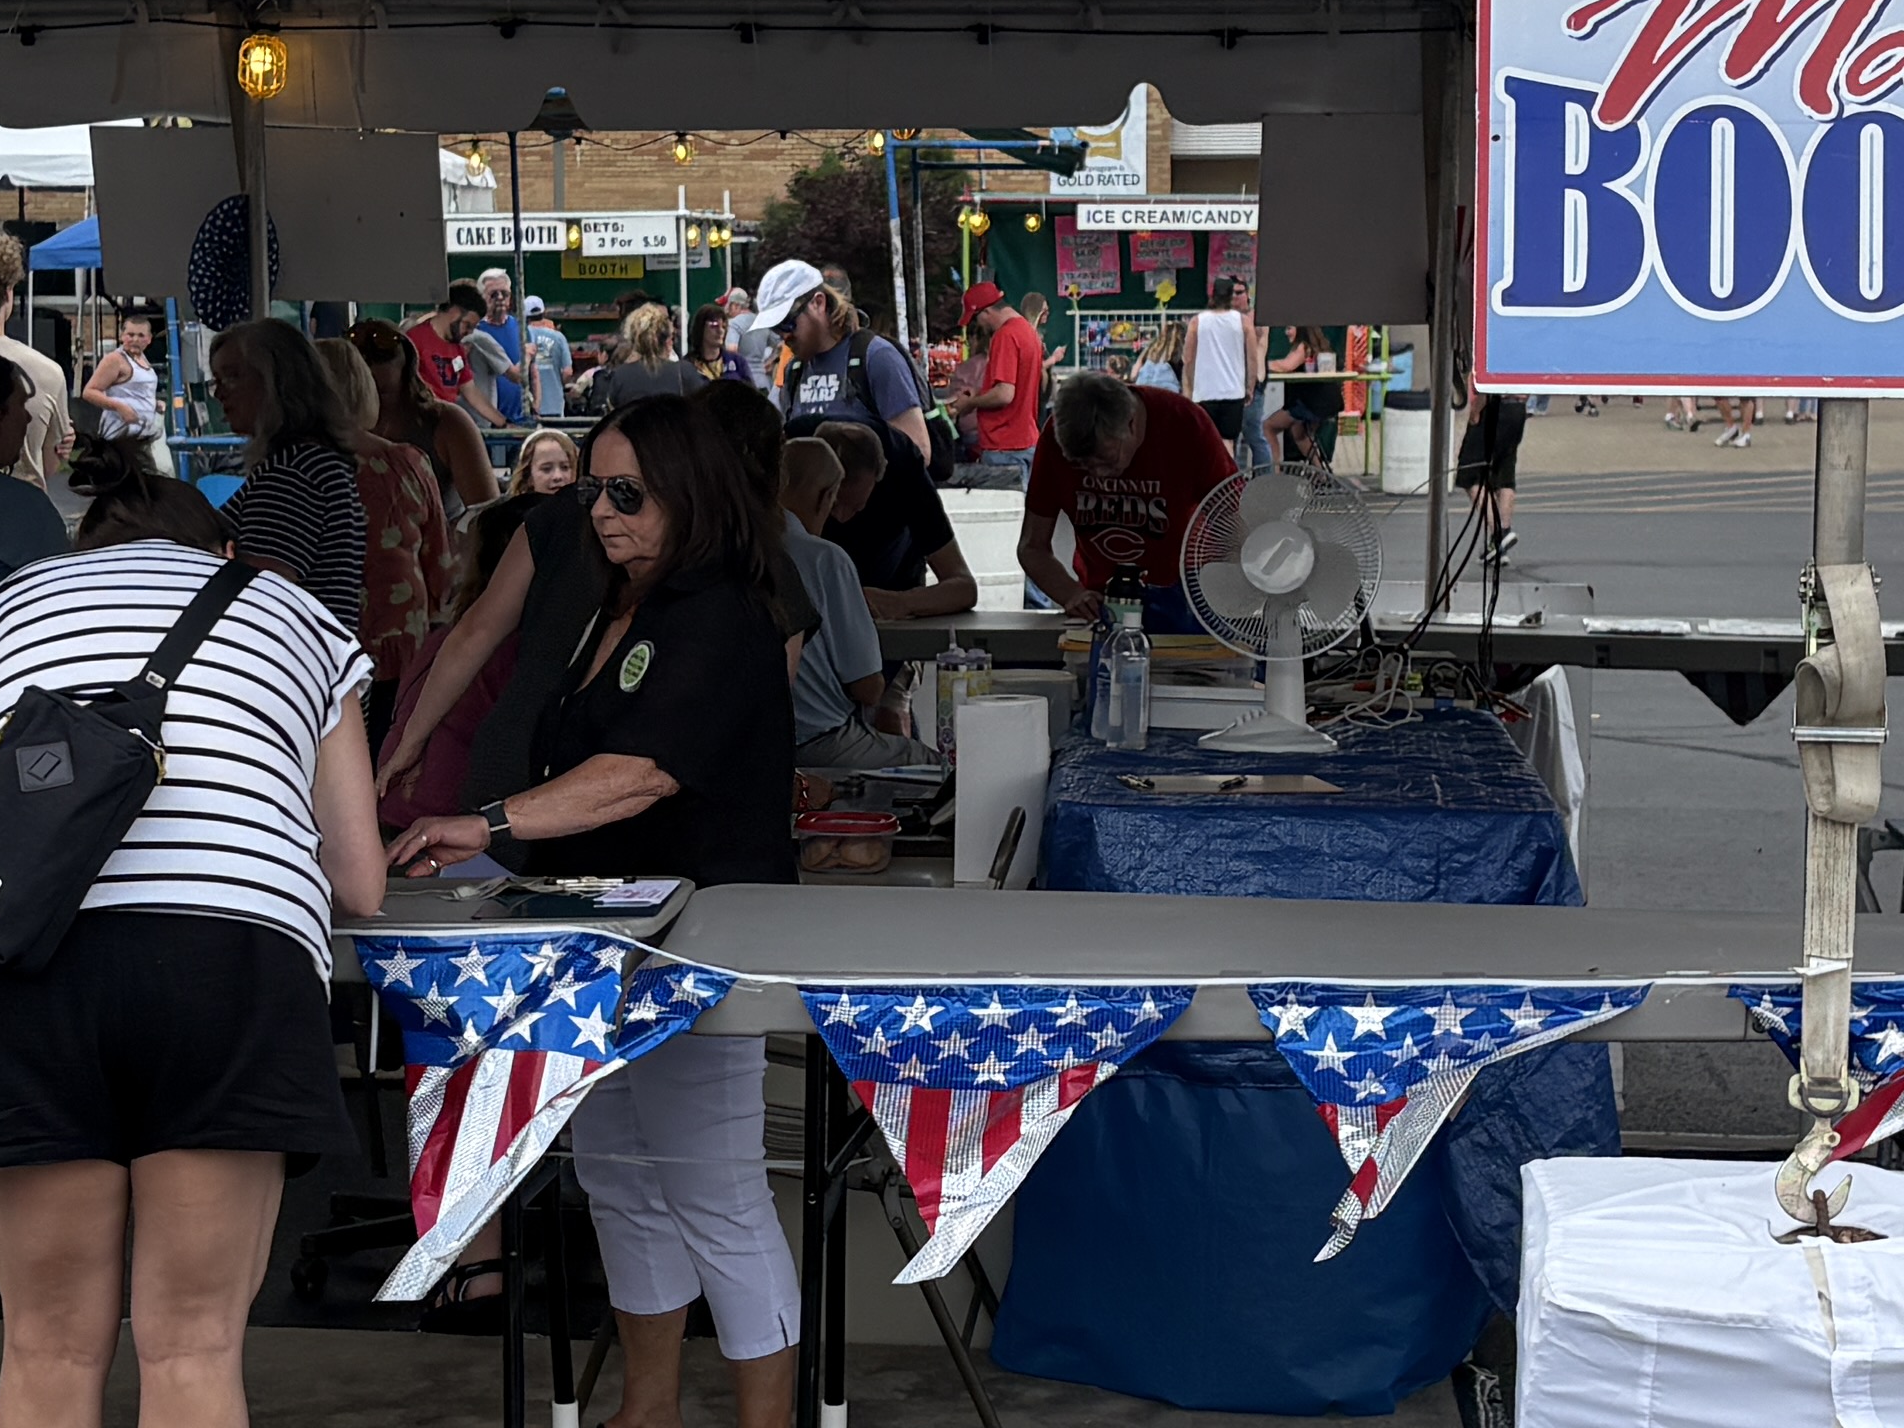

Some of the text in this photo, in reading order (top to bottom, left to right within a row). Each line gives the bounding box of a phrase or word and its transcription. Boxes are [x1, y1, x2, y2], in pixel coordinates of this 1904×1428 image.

[1057, 173, 1141, 187] GOLD RATED
[1086, 210, 1254, 224] ICE CREAM/CANDY
[456, 226, 558, 246] CAKE BOTH
[578, 262, 628, 276] BOOTH
[1075, 491, 1170, 533] REDS
